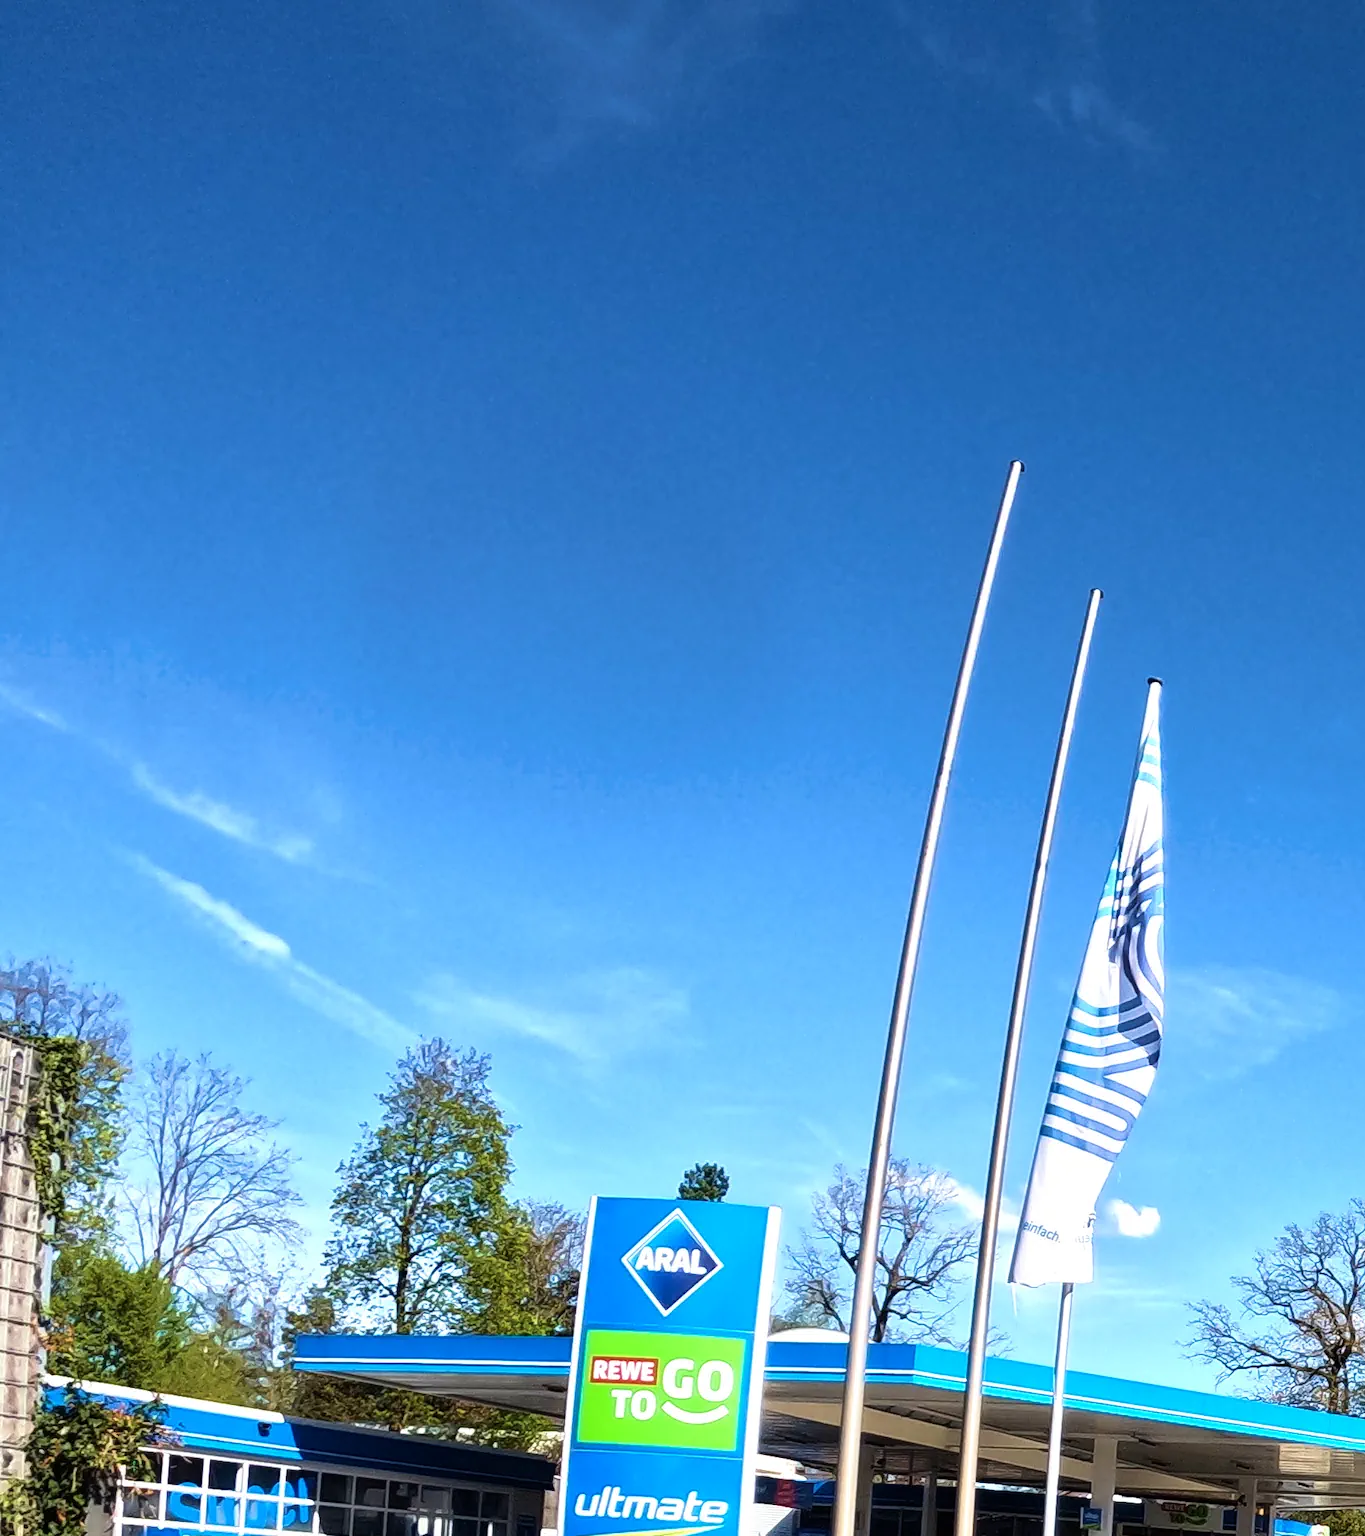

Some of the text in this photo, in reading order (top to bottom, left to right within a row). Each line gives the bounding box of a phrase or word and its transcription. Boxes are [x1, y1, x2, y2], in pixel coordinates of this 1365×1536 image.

[1023, 1221, 1061, 1243] einfach.
[635, 1246, 707, 1275] ARAL
[593, 1358, 734, 1402] REWE GO
[610, 1389, 657, 1421] TO
